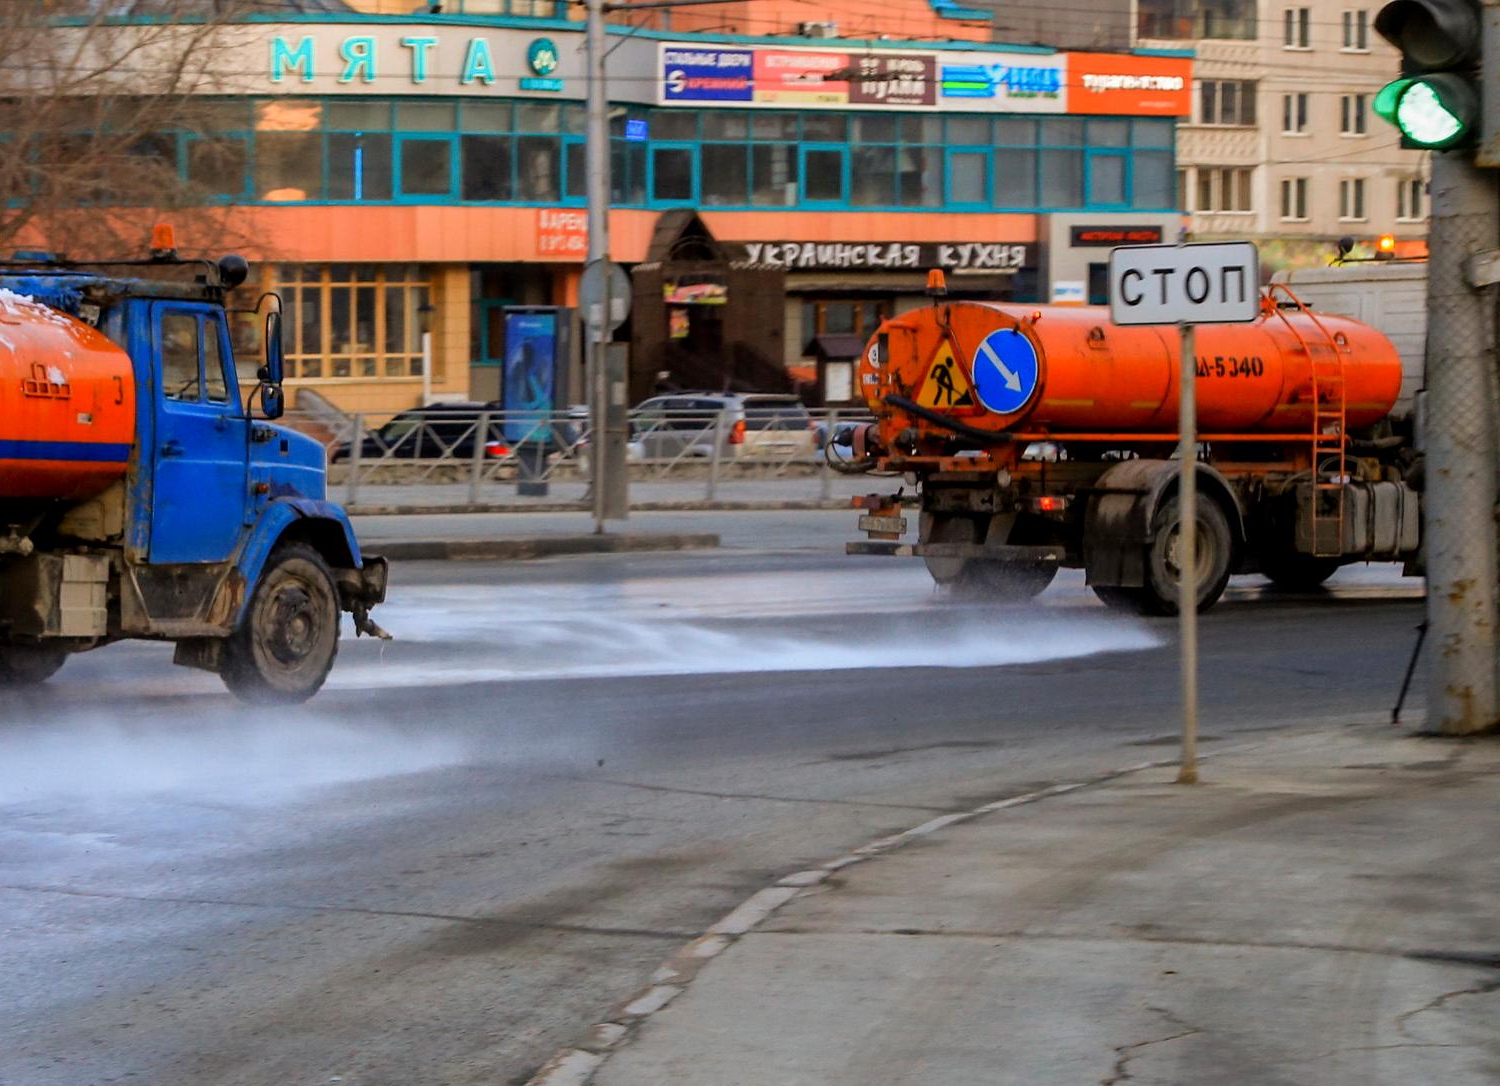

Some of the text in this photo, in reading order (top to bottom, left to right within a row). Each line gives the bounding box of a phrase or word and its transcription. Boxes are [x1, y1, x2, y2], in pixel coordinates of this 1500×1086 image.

[270, 35, 496, 86] МЯТА
[744, 242, 1027, 268] УКРАИНСКАЯ КУХНЯ
[1120, 266, 1245, 306] СТОП
